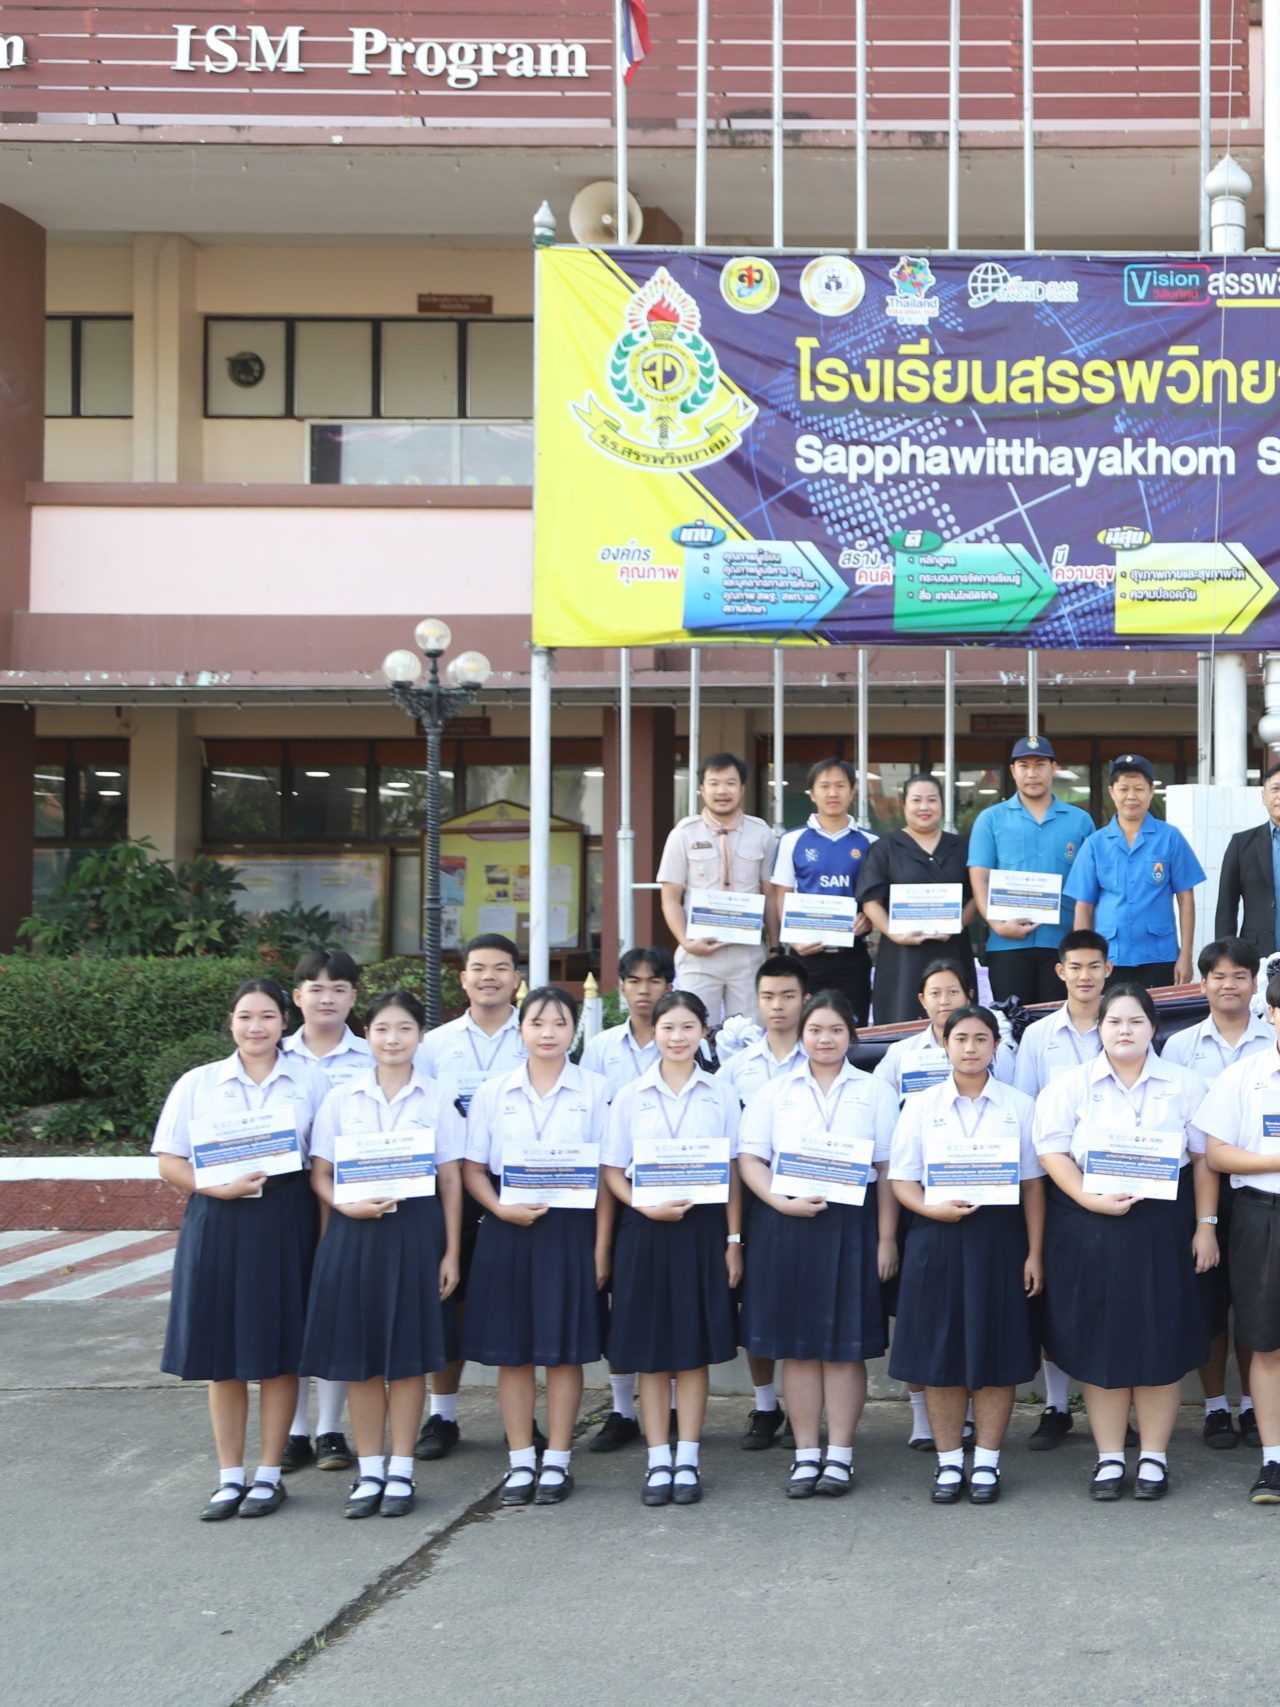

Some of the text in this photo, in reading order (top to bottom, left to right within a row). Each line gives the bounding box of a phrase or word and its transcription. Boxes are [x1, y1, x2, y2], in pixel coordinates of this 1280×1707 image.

[172, 24, 589, 89] ISM Program
[1130, 270, 1200, 299] Vision
[889, 298, 937, 308] Thailand
[794, 435, 1236, 487] Sapphawitthayakhom
[600, 540, 652, 562] องค์กร
[841, 541, 879, 566] สร้าง
[619, 566, 679, 584] คุณภาพ
[858, 567, 892, 583] คนดี
[1054, 566, 1114, 587] ความสุข
[820, 875, 850, 888] SAN
